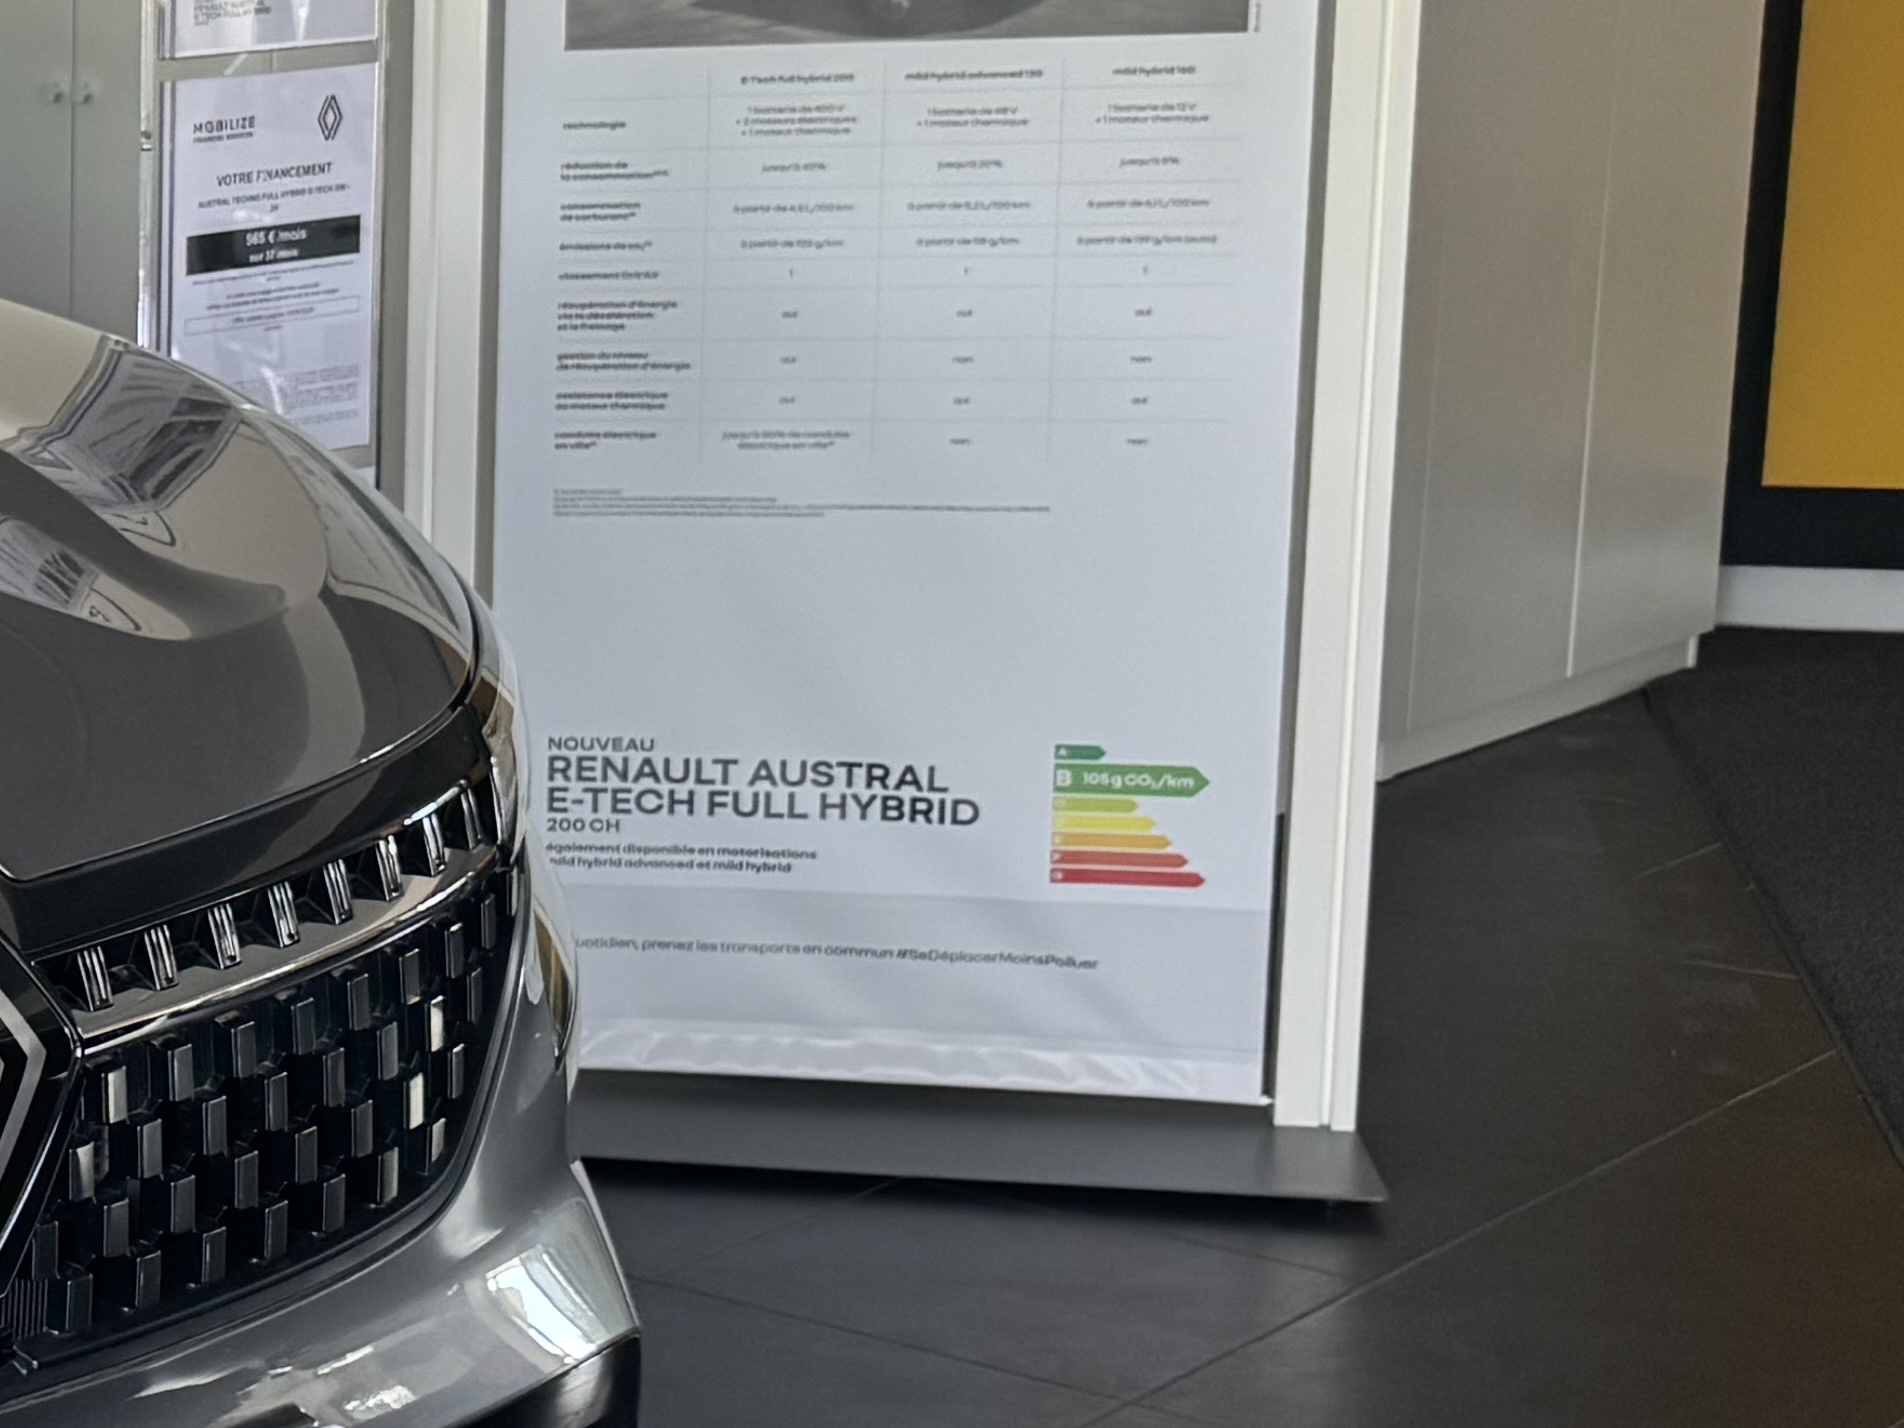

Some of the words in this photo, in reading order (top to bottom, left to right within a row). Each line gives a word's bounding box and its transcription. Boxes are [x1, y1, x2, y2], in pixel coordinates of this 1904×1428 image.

[193, 115, 256, 134] MOBILIZE
[216, 170, 254, 187] VOTRE
[548, 736, 655, 752] NOUVEAU
[547, 755, 739, 786] RENAULT
[747, 758, 949, 794] AUSTRAL
[1056, 769, 1072, 787] B
[547, 786, 695, 816] E-TECH
[707, 790, 809, 819] FULL
[819, 792, 980, 826] HYBRID
[547, 818, 586, 833] 200
[589, 818, 620, 833] CH
[622, 843, 696, 857] disponible
[697, 847, 715, 856] en
[577, 856, 622, 870] hybrid
[713, 859, 743, 872] mild
[745, 861, 792, 874] hybrid
[577, 937, 639, 951] uotidien,
